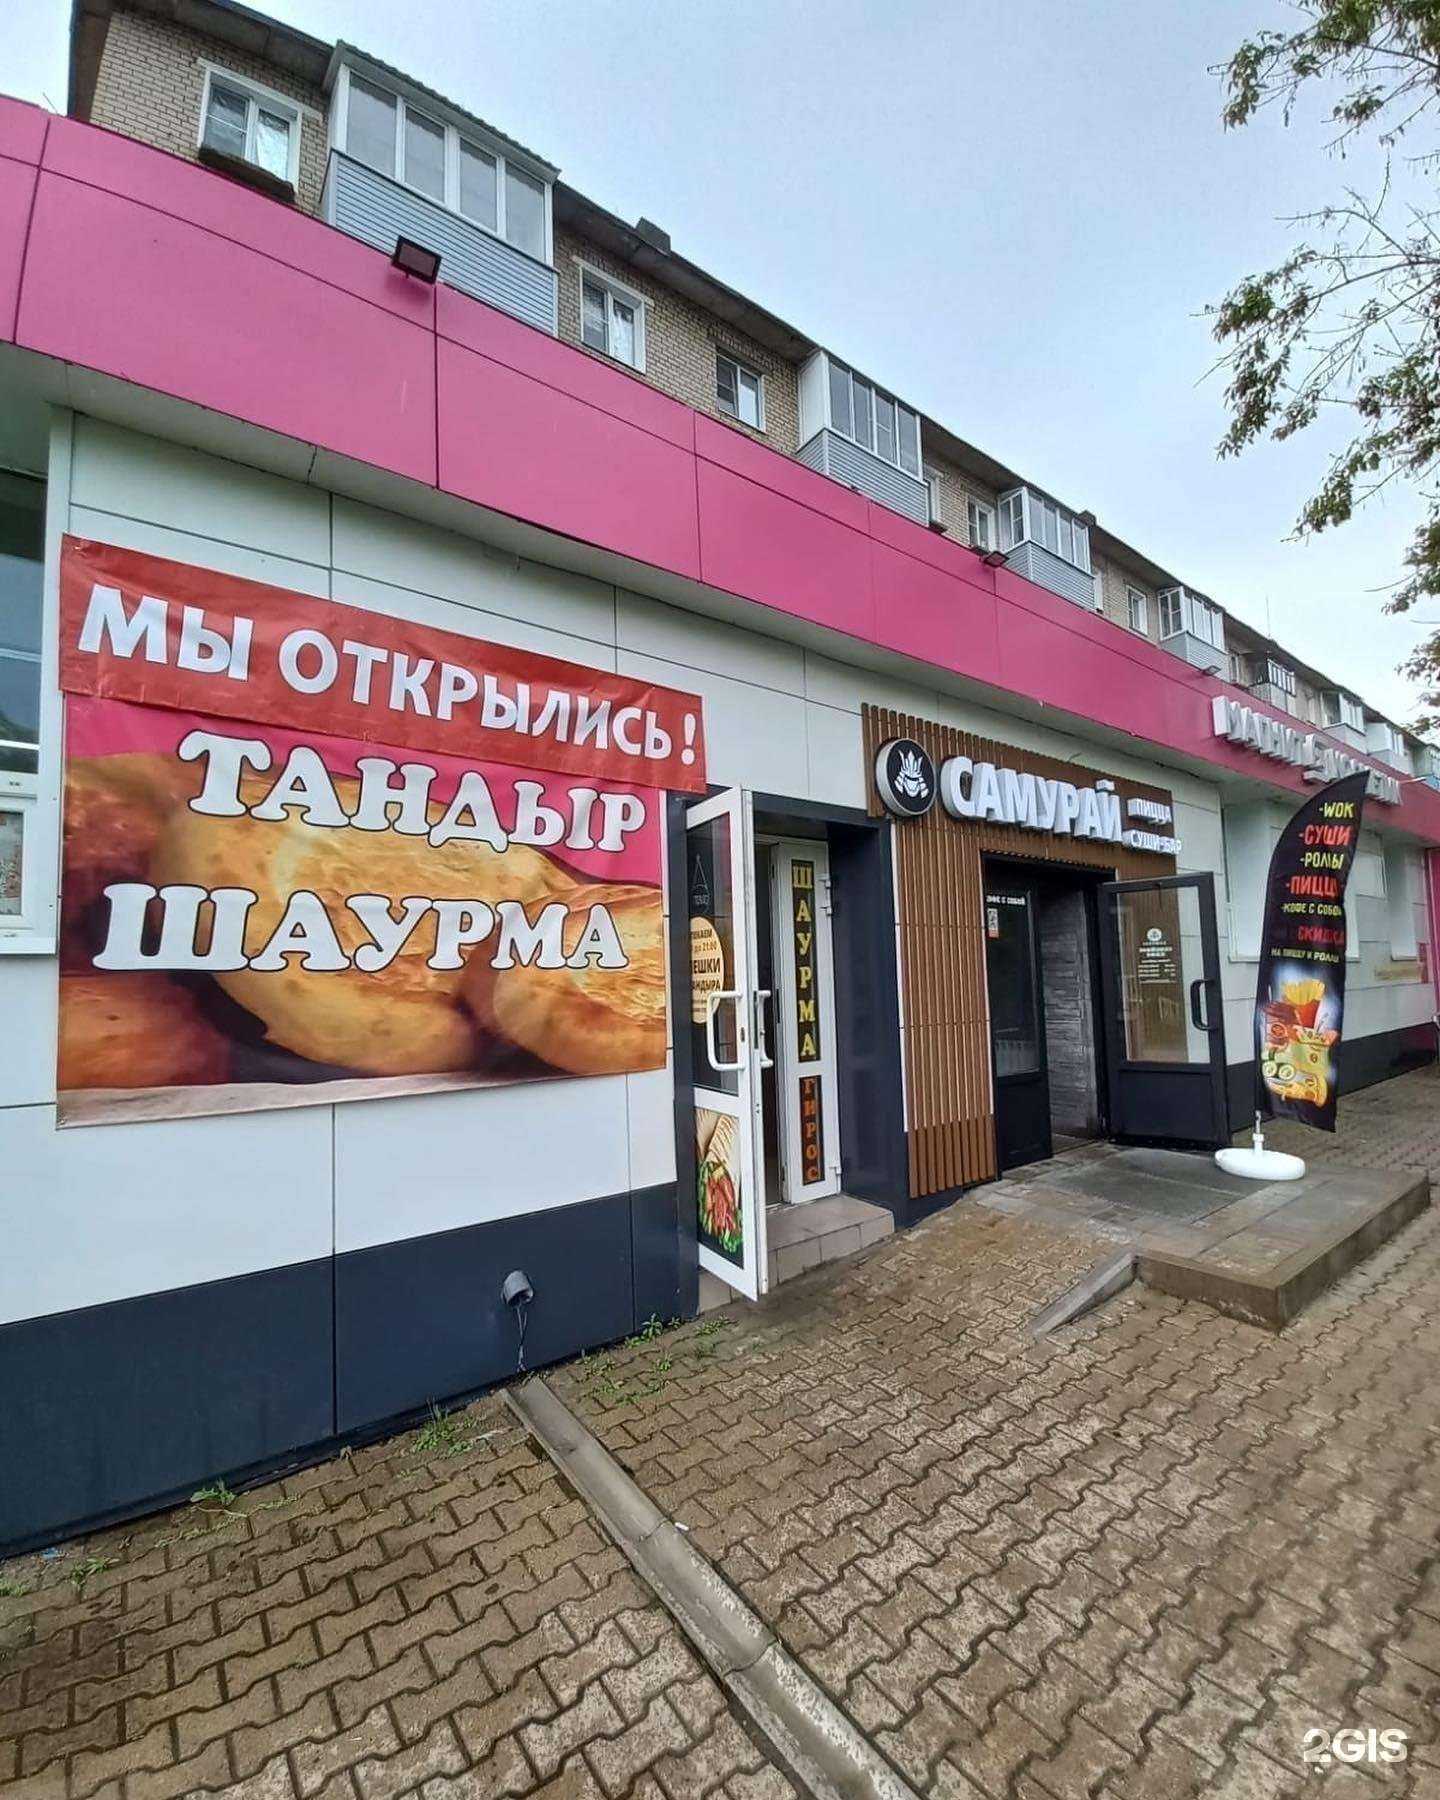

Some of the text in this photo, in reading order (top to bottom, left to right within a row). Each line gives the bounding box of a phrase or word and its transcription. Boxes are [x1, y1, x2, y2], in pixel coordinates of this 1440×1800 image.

[78, 583, 254, 680] МЫ
[178, 729, 646, 853] ТАНДЫР
[940, 756, 1123, 843] САМУРАЙ
[1127, 797, 1173, 825] ПИЦЦА
[1121, 829, 1182, 855] СУШИ-БАР
[91, 883, 628, 972] ШАУРМА
[1308, 903, 1315, 914] С
[694, 958, 720, 974] ЕШКИ
[792, 865, 816, 1057] ШАУРМА
[803, 1078, 819, 1181] ГИРОС
